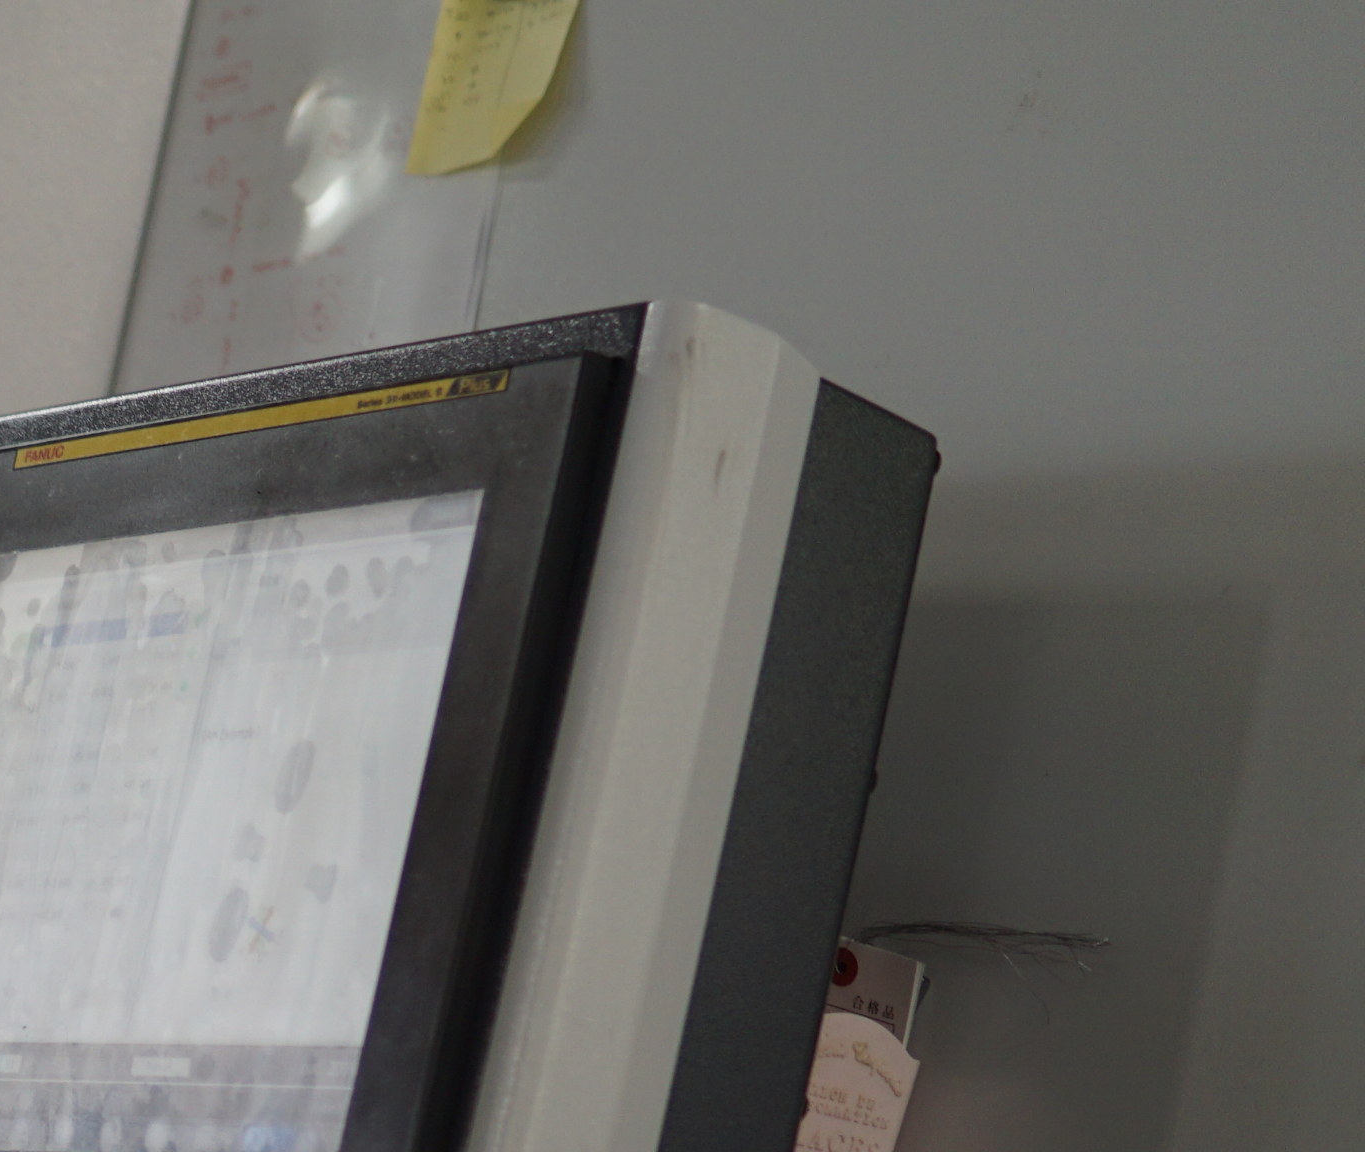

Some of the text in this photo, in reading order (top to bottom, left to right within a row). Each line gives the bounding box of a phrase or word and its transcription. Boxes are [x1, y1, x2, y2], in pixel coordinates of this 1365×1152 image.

[24, 445, 65, 463] FANUC
[852, 995, 895, 1020] 合格品
